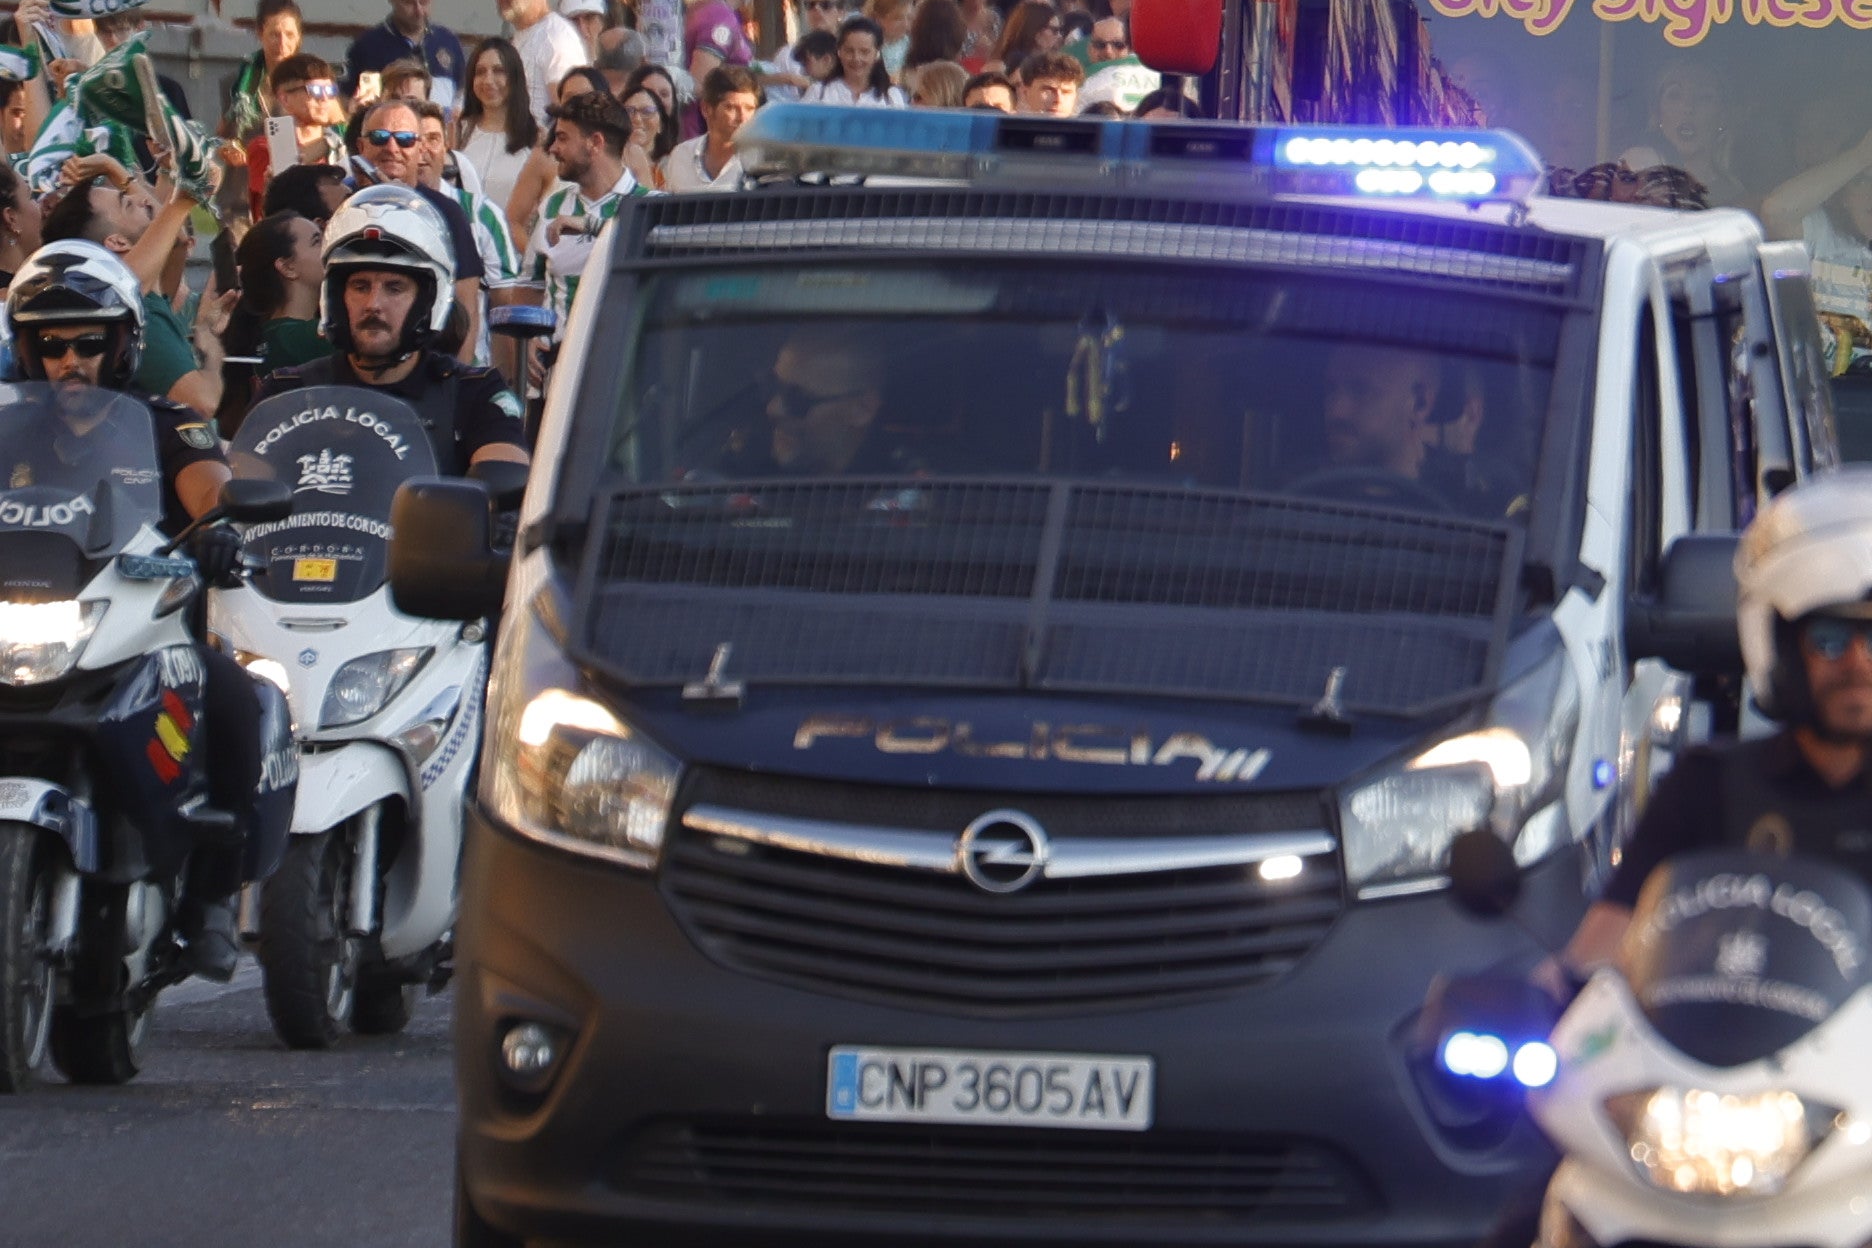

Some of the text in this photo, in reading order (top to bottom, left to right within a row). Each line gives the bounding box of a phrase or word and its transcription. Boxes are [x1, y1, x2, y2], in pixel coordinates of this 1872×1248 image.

[254, 404, 412, 460] POLICIA LOCAL
[793, 713, 1226, 782] POLICIA
